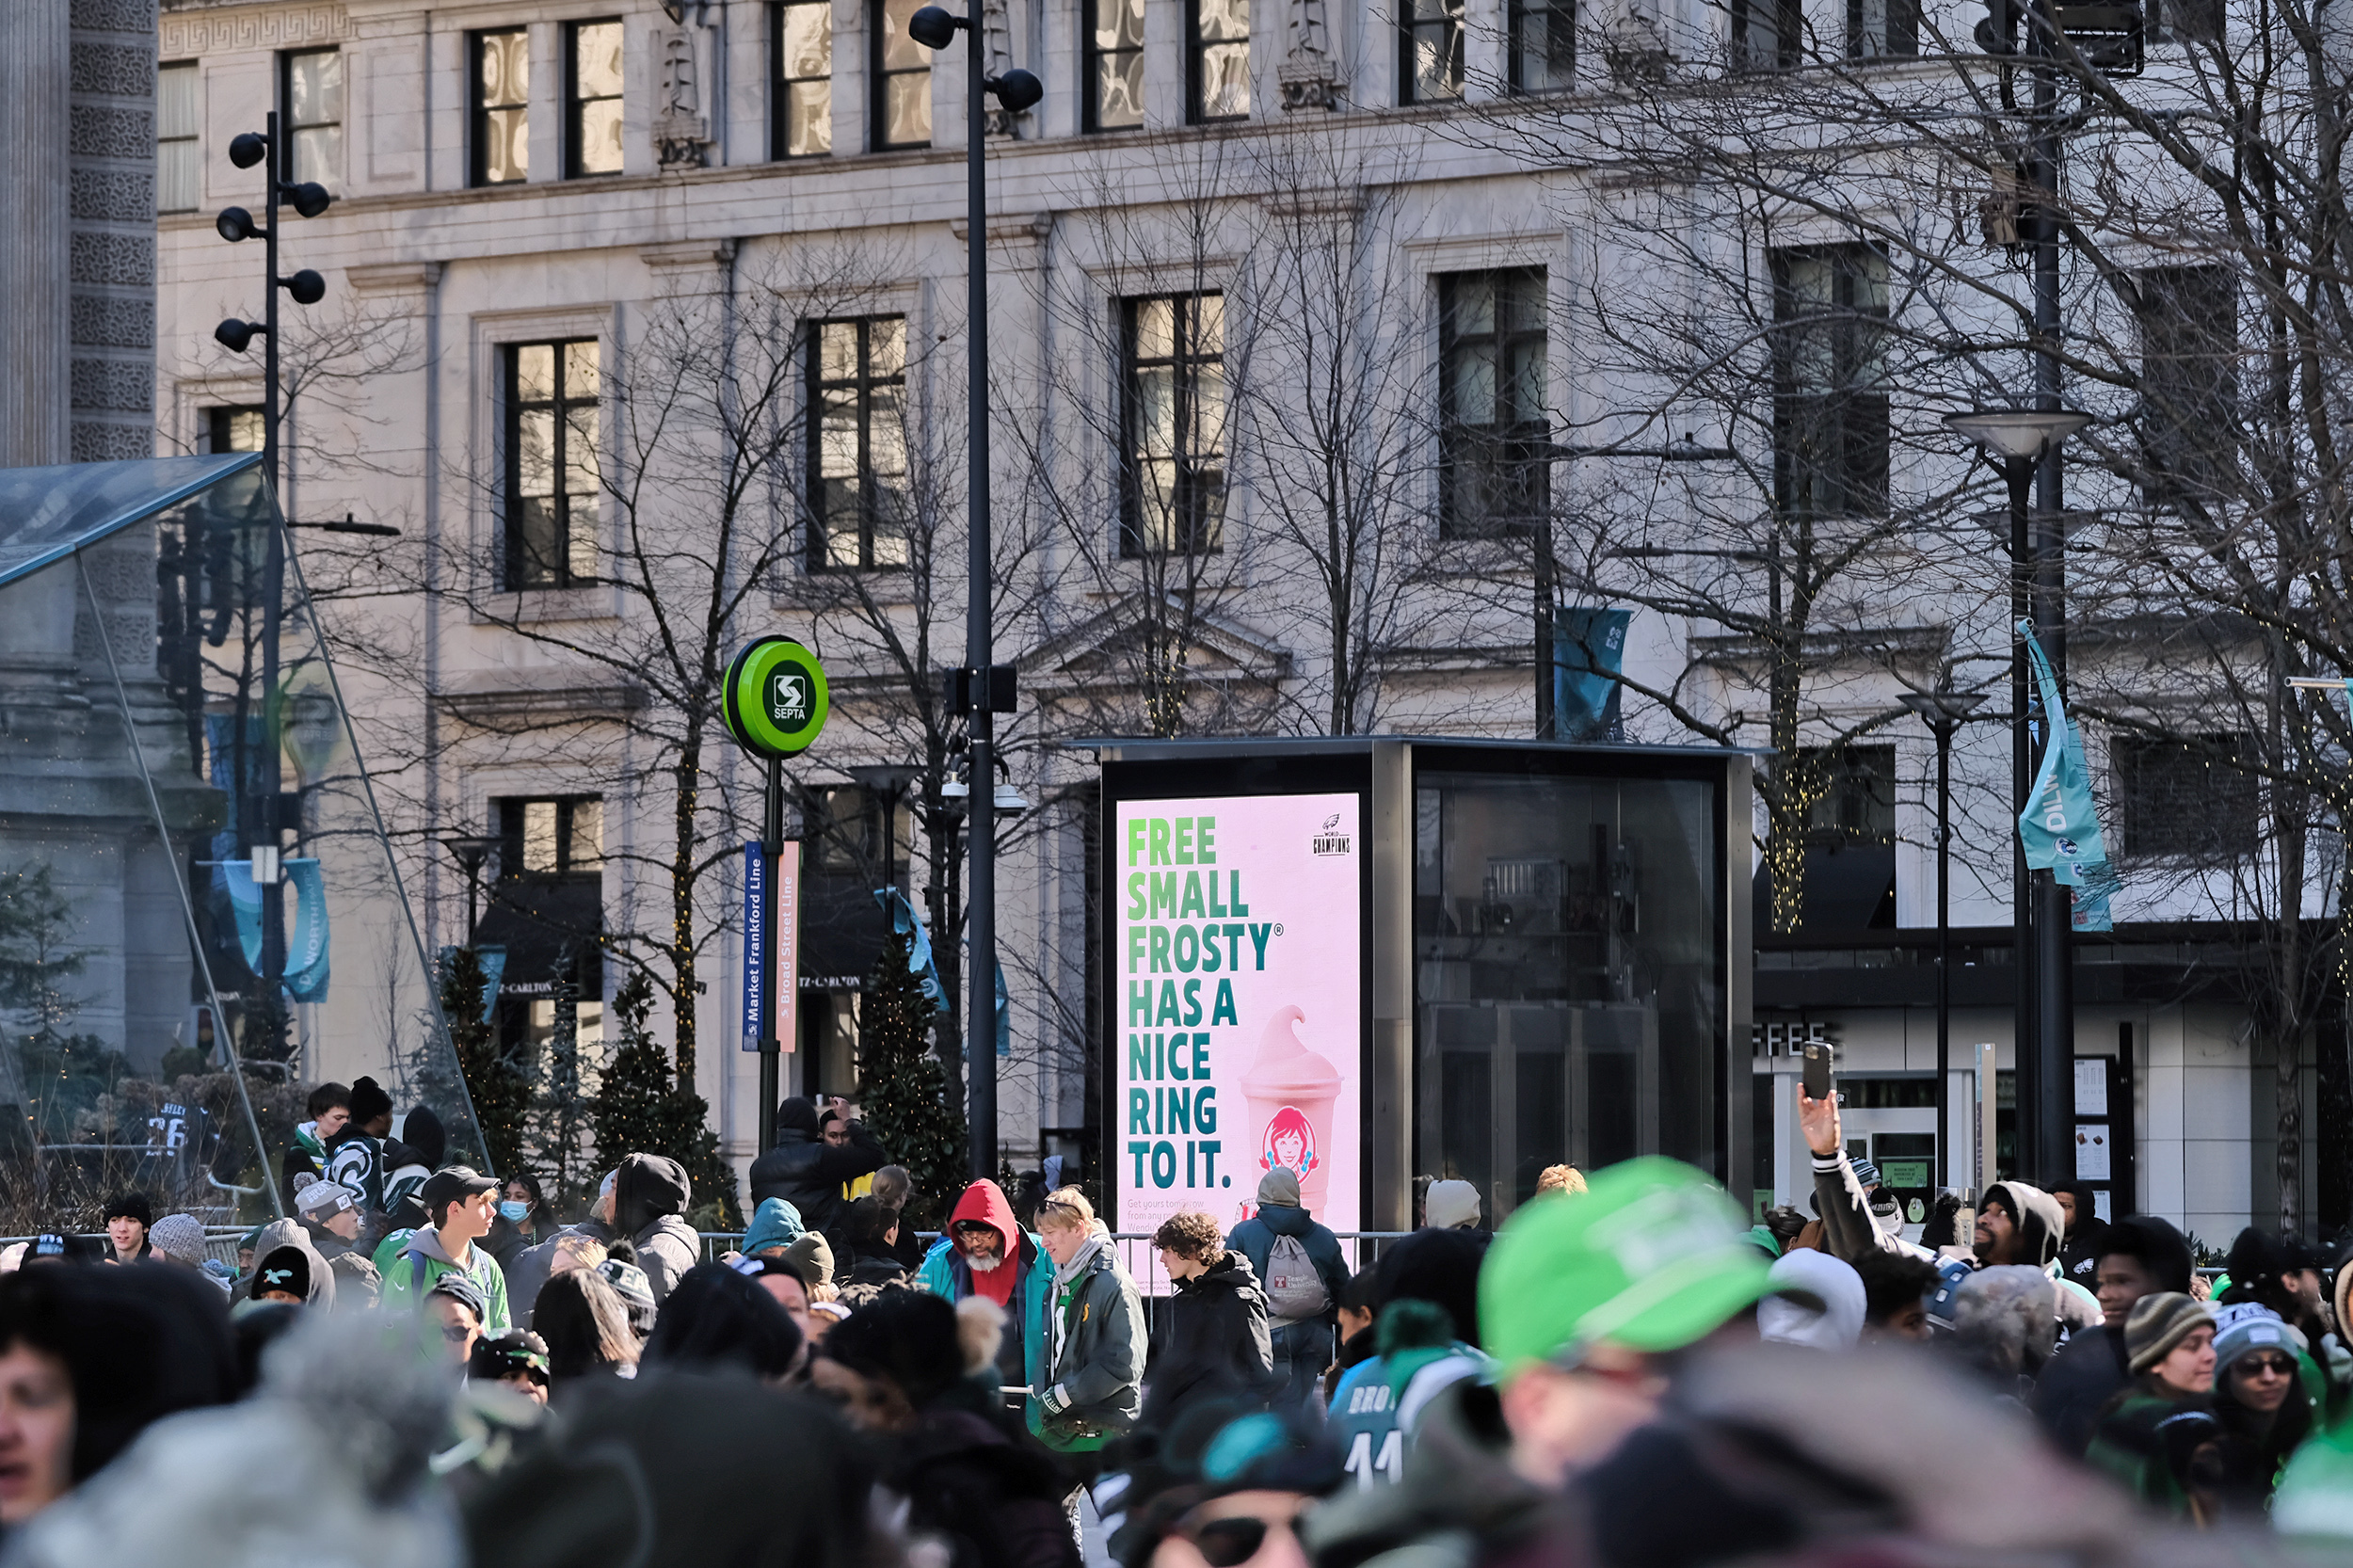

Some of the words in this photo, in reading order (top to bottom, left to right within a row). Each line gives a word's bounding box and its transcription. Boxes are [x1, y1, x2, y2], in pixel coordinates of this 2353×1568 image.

[775, 708, 806, 720] SEPTA
[2041, 760, 2067, 832] DILW
[1128, 816, 1217, 867] FREE
[1313, 838, 1350, 854] CHAMPIONS
[750, 858, 761, 889] Line
[782, 876, 792, 907] Line
[1128, 870, 1249, 920] SMALL
[299, 904, 321, 985] DWORTH
[749, 894, 760, 965] Frankford
[781, 911, 792, 956] Street
[748, 968, 760, 1021] Market
[780, 961, 791, 1003] Broad
[1128, 978, 1203, 1028] HAS
[1211, 978, 1239, 1027] A
[1128, 1032, 1210, 1080] NICE
[1128, 1086, 1217, 1135] RING
[1128, 1141, 1176, 1189] TO
[1187, 1141, 1231, 1189] IT.
[1128, 1199, 1141, 1208] Get
[1143, 1201, 1164, 1209] yours
[1128, 1211, 1145, 1220] from
[1148, 1213, 1162, 1222] any
[1347, 1384, 1395, 1414] BRO
